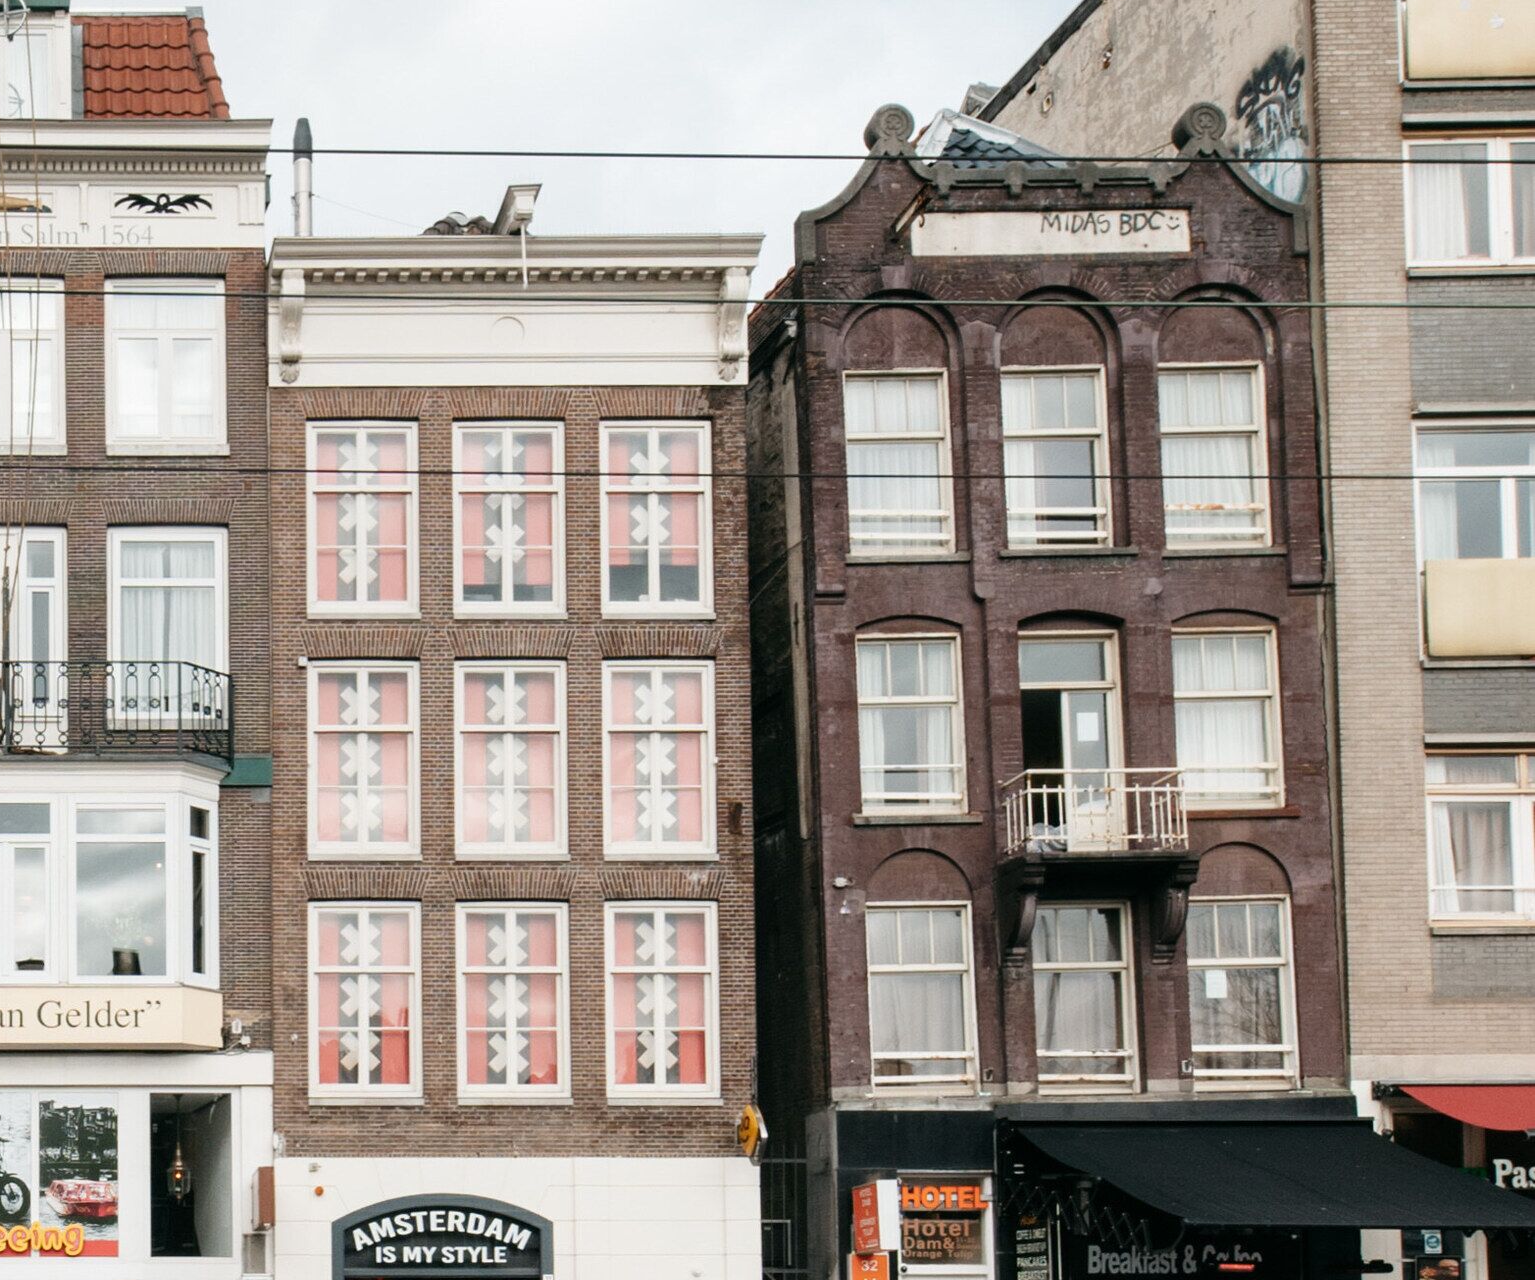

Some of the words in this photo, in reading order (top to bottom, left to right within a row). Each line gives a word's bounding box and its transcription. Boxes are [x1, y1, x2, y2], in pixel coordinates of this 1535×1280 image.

[1041, 212, 1110, 235] MIDAS
[1120, 211, 1164, 235] BDC
[101, 224, 154, 245] 1564
[901, 1185, 989, 1210] HOTEL
[352, 1210, 532, 1251] AMSTERDAM
[904, 1219, 970, 1236] Hotel
[375, 1246, 397, 1264] IS
[403, 1246, 438, 1264] MY
[441, 1246, 508, 1264] STYLE
[904, 1250, 942, 1259] Orange
[947, 1249, 974, 1259] Tulip
[1088, 1245, 1178, 1274] Breakfast
[1182, 1245, 1197, 1274] &
[862, 1260, 878, 1271] 32
